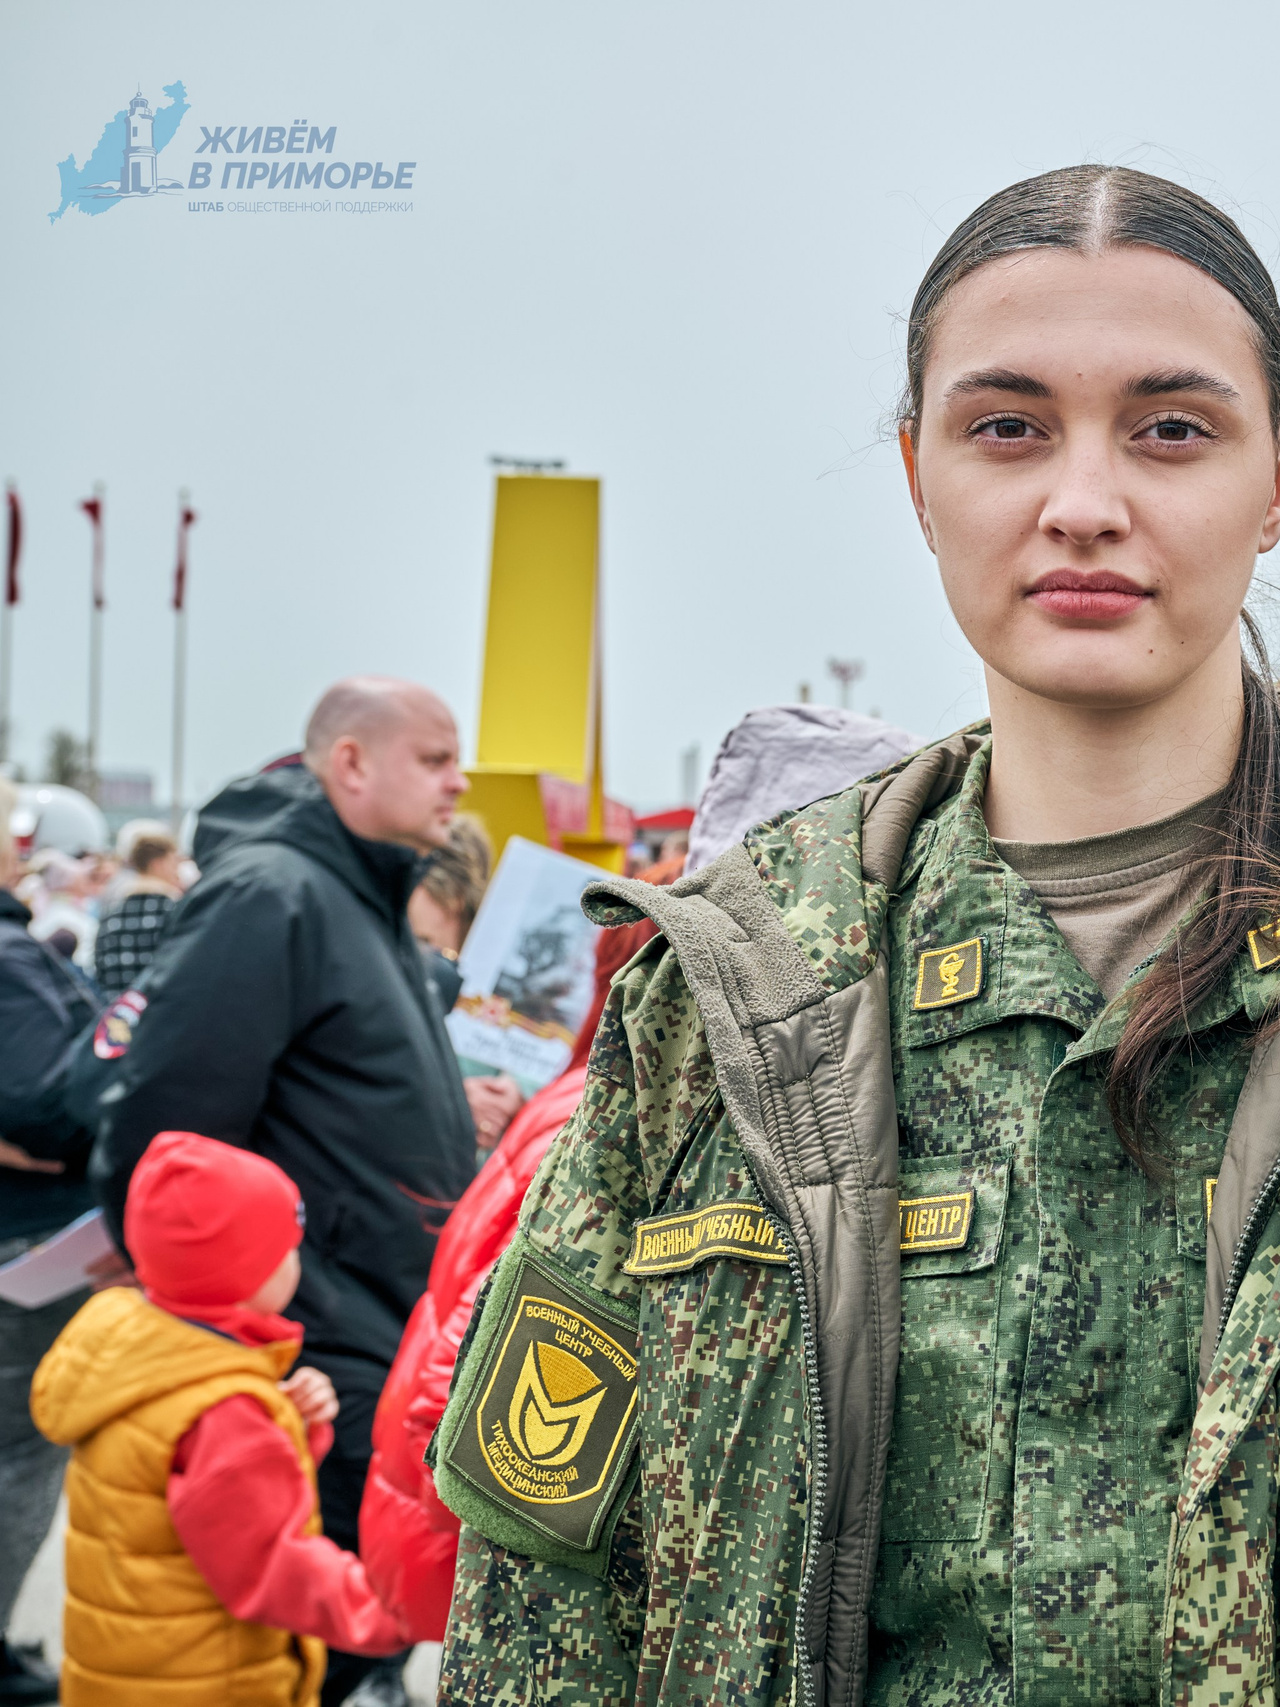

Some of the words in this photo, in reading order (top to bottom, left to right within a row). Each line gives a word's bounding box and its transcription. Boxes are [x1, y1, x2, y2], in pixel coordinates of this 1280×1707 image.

[641, 1216, 703, 1261] ВОЕННЫЙ
[905, 1205, 961, 1243] ЦЕНТР
[526, 1305, 581, 1335] ВОЕННЫЙ
[580, 1326, 637, 1382] УЧЕБНЫЙ
[554, 1329, 594, 1358] ЦЕНТР
[487, 1441, 569, 1498] МЕДИЦИНСКИЙ
[491, 1419, 579, 1484] ТИХООКЕАНСКИЙ
